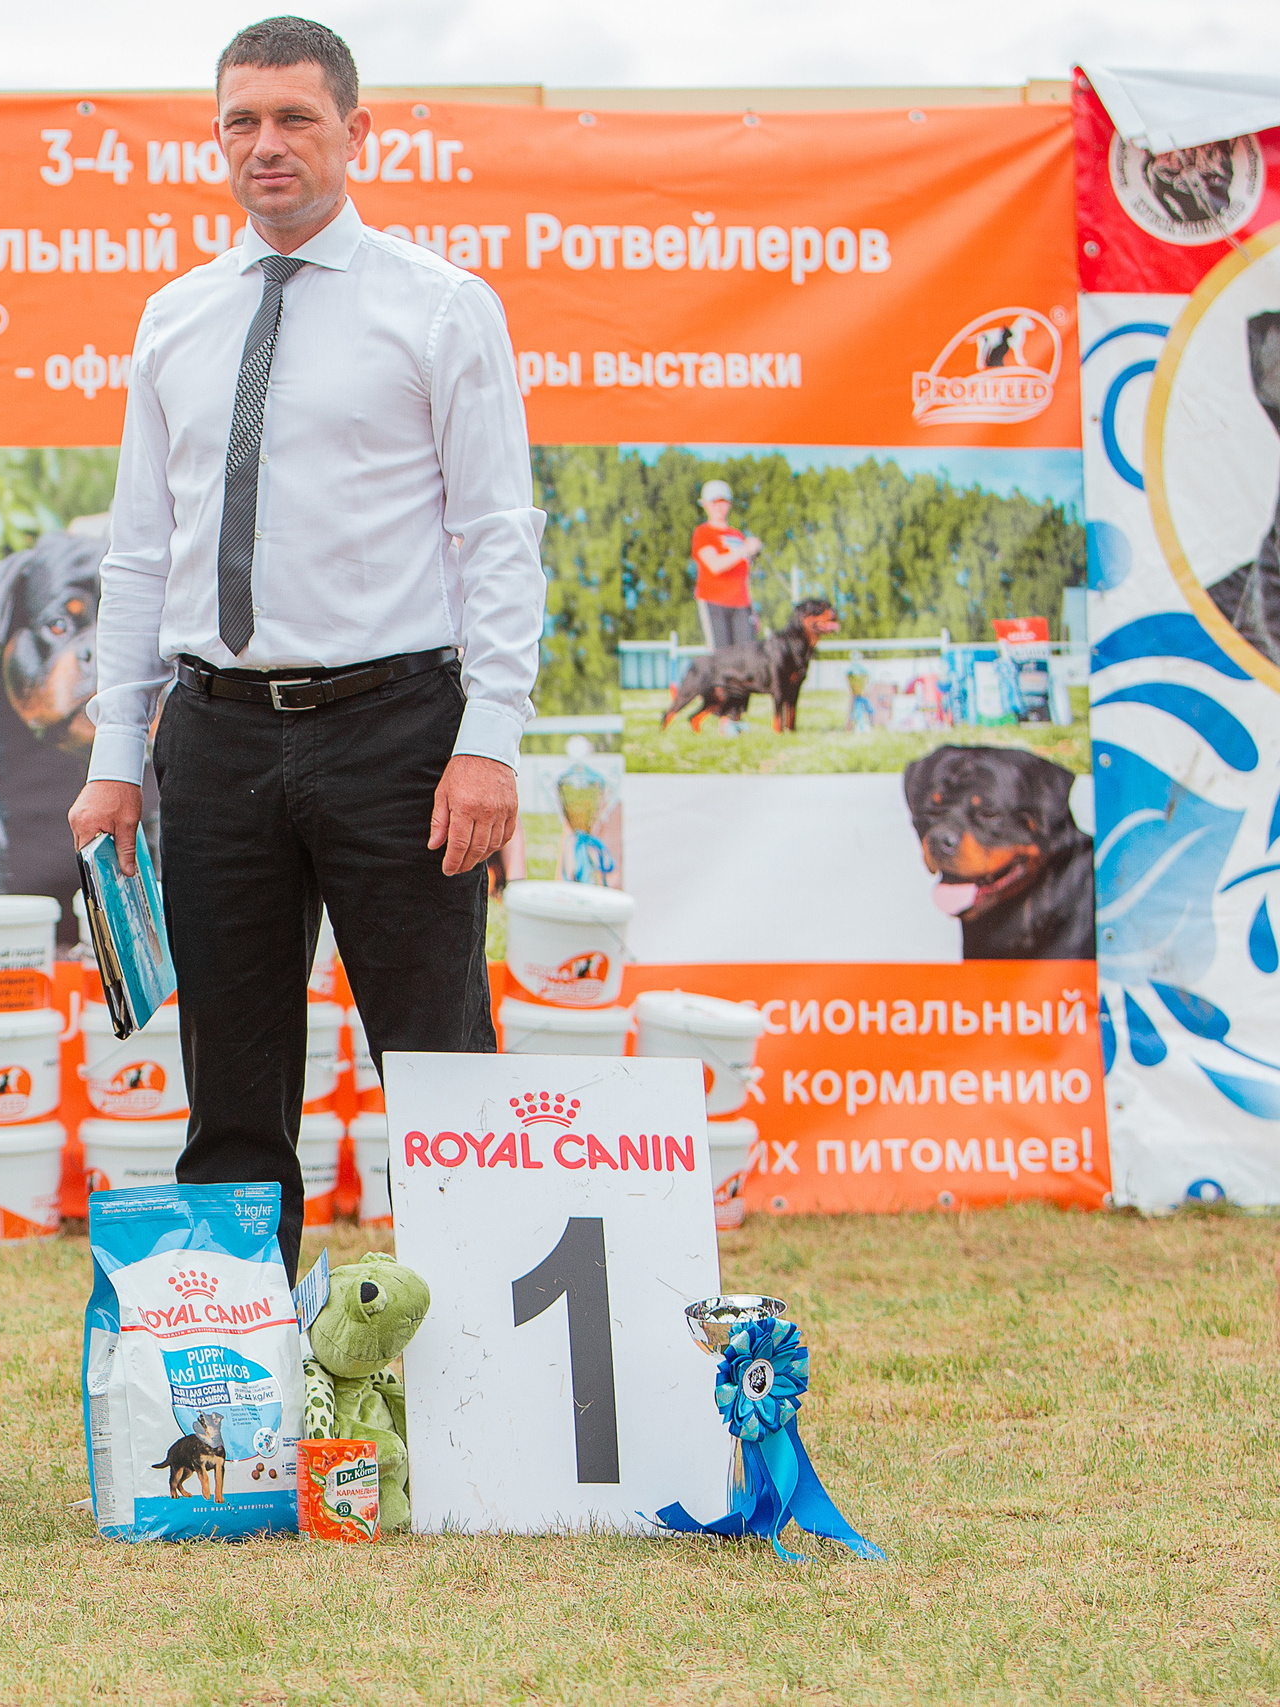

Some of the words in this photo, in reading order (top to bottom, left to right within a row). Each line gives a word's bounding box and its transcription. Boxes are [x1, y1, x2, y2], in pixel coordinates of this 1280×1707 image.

[40, 128, 132, 186] 3-4
[147, 139, 228, 185] ию
[348, 128, 472, 184] 021г.
[526, 210, 891, 285] Ротвейлеров
[593, 349, 803, 389] выставки
[754, 989, 1087, 1036] сиональный
[783, 1067, 1092, 1116] кормлению
[404, 1130, 544, 1169] ROYAL
[553, 1133, 696, 1172] CANIN
[816, 1126, 1093, 1181] питомцев!
[235, 1203, 242, 1217] 3
[204, 1298, 272, 1325] CANIN
[187, 1348, 224, 1366] PUPPY
[511, 1216, 620, 1484] 1
[170, 1367, 196, 1384] ДЛЯ
[198, 1363, 251, 1382] ЩЕНКОВ
[203, 1385, 226, 1395] СОБАК
[340, 1471, 354, 1484] Dr.
